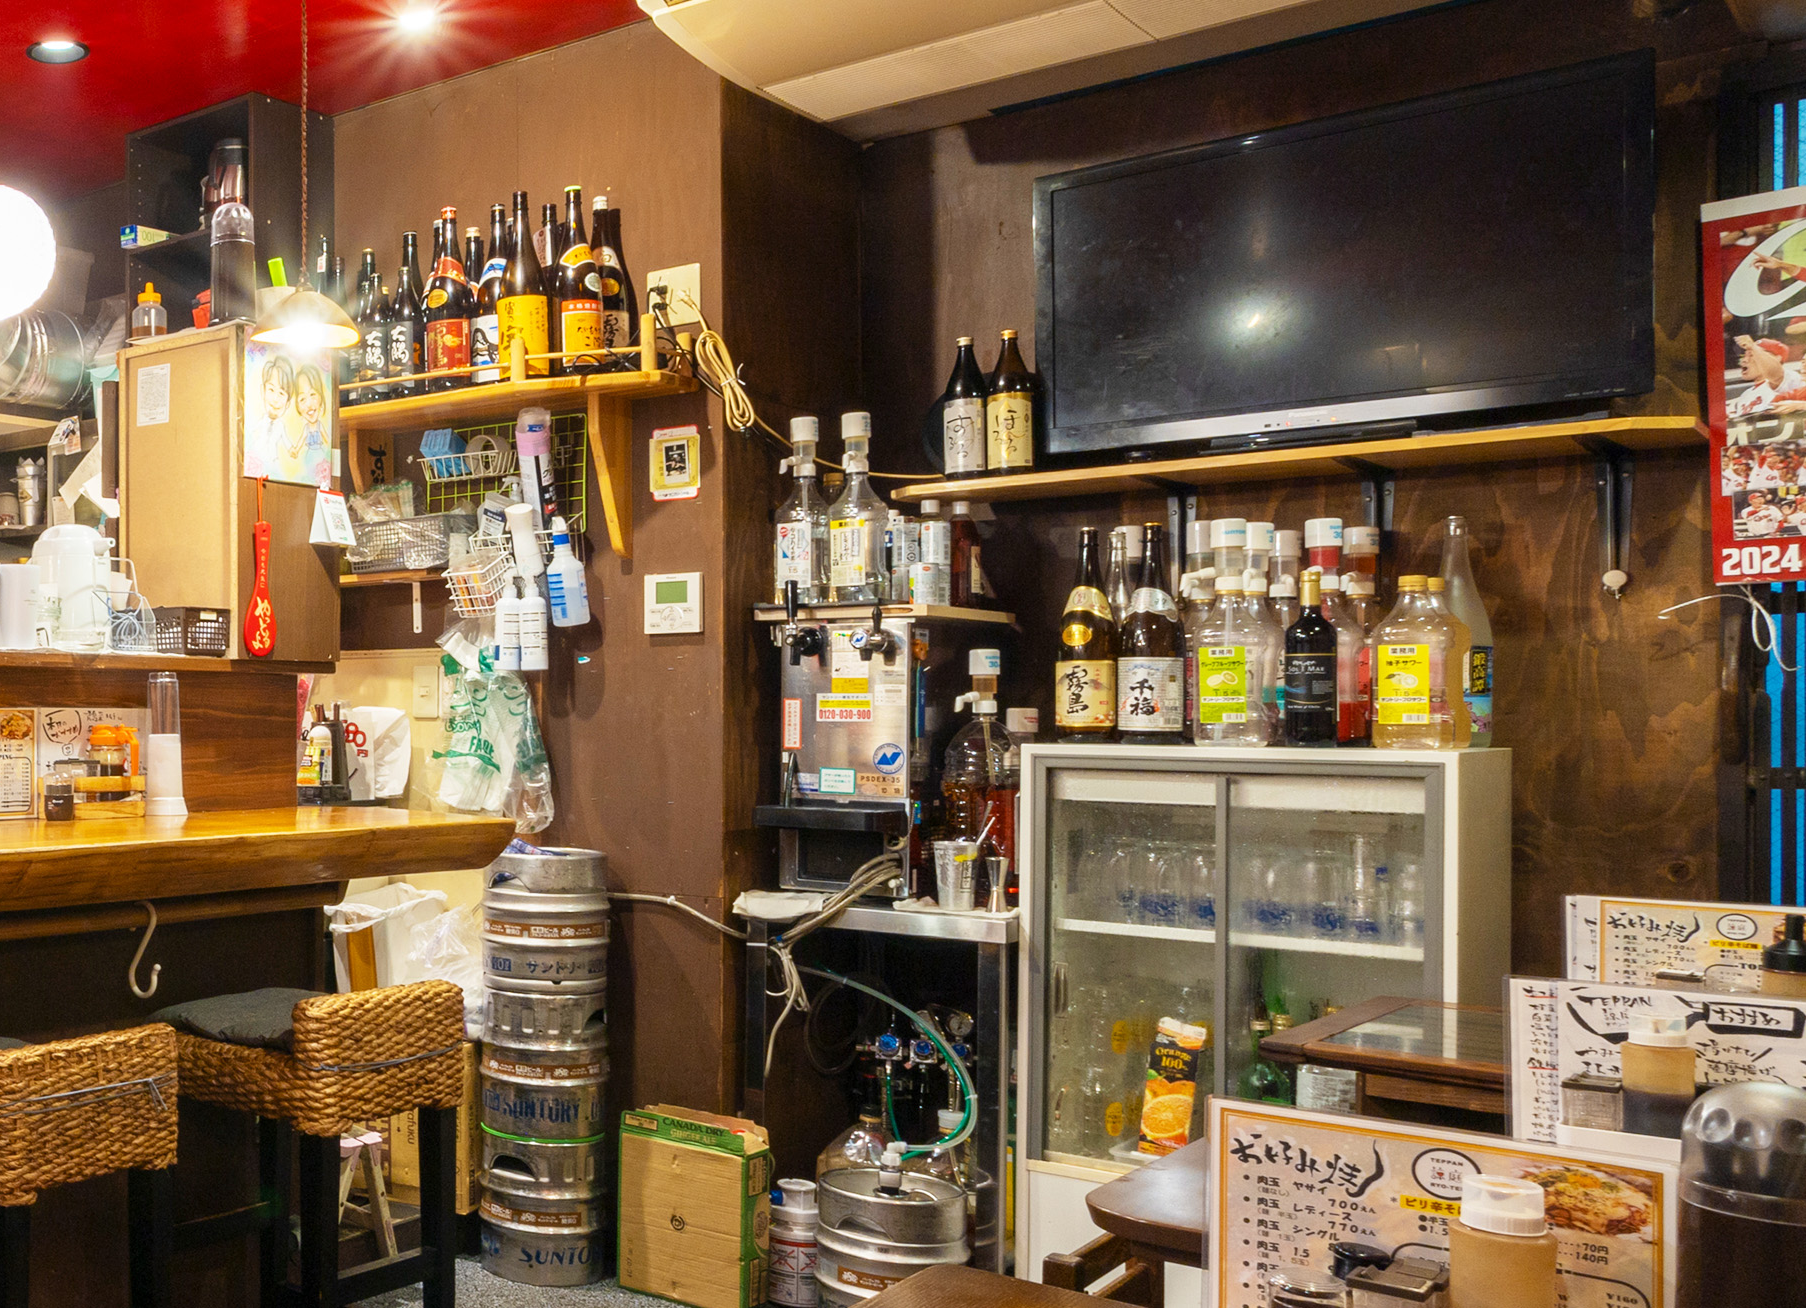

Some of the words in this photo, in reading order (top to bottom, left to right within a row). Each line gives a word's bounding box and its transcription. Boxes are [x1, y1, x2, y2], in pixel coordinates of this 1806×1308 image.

[365, 331, 385, 368] 大隅
[390, 325, 409, 363] 大隅
[1722, 543, 1805, 576] 2024
[1390, 647, 1416, 655] 業務用
[1066, 665, 1089, 714] 霧島
[1129, 678, 1155, 716] 千福
[819, 709, 871, 720] 0120-030-900
[1607, 912, 1701, 943] お好み焼
[1576, 995, 1653, 1008] TEPPAN
[1712, 1008, 1781, 1027] おすすめ
[1156, 1046, 1192, 1061] Orange
[662, 1117, 703, 1133] CANADA
[705, 1126, 725, 1137] DRY
[1230, 1134, 1385, 1198] お好み焼
[1430, 1157, 1464, 1167] TEPPAN
[1257, 1175, 1280, 1187] 肉玉
[1293, 1181, 1328, 1195] ヤサイ
[1257, 1197, 1280, 1209] 肉玉
[1293, 1203, 1353, 1222] レディース
[1327, 1198, 1377, 1215] 700えん
[1257, 1219, 1280, 1231] 肉玉
[1293, 1224, 1340, 1242] シングル
[1327, 1220, 1377, 1237] 770えん
[1257, 1241, 1280, 1252] 肉玉
[1293, 1247, 1310, 1258] 1.5
[1575, 1251, 1609, 1265] 140円
